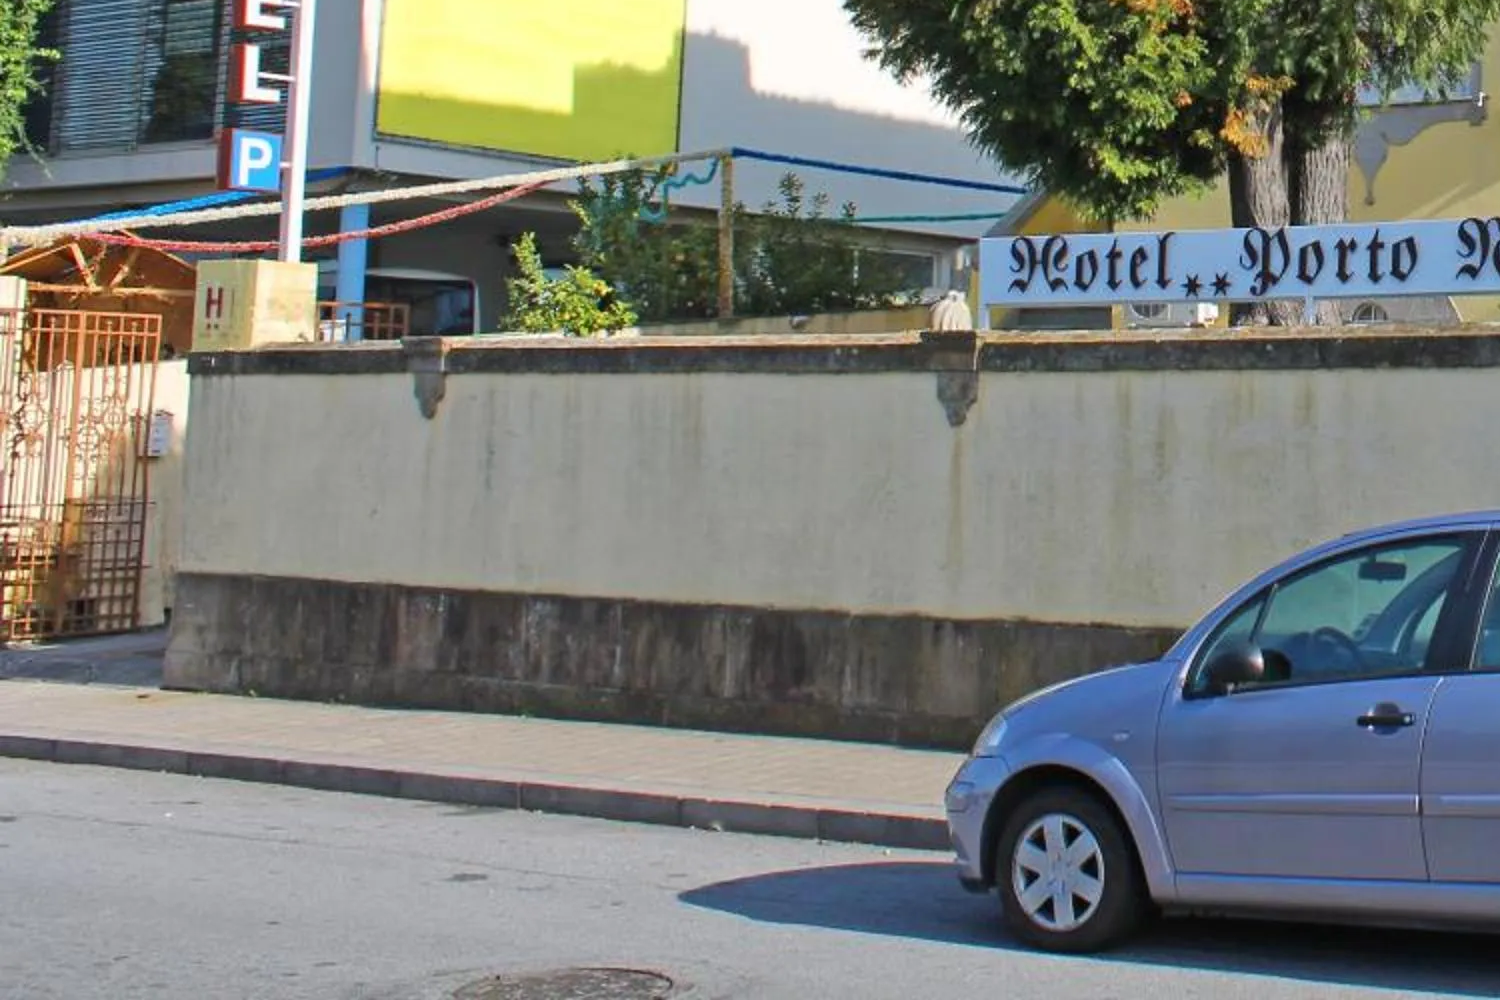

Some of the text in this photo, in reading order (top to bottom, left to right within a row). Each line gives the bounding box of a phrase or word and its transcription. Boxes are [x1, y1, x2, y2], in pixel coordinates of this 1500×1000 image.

[239, 137, 273, 187] P
[1008, 232, 1175, 293] Hotel
[1240, 227, 1418, 296] Porto
[206, 287, 223, 318] H
